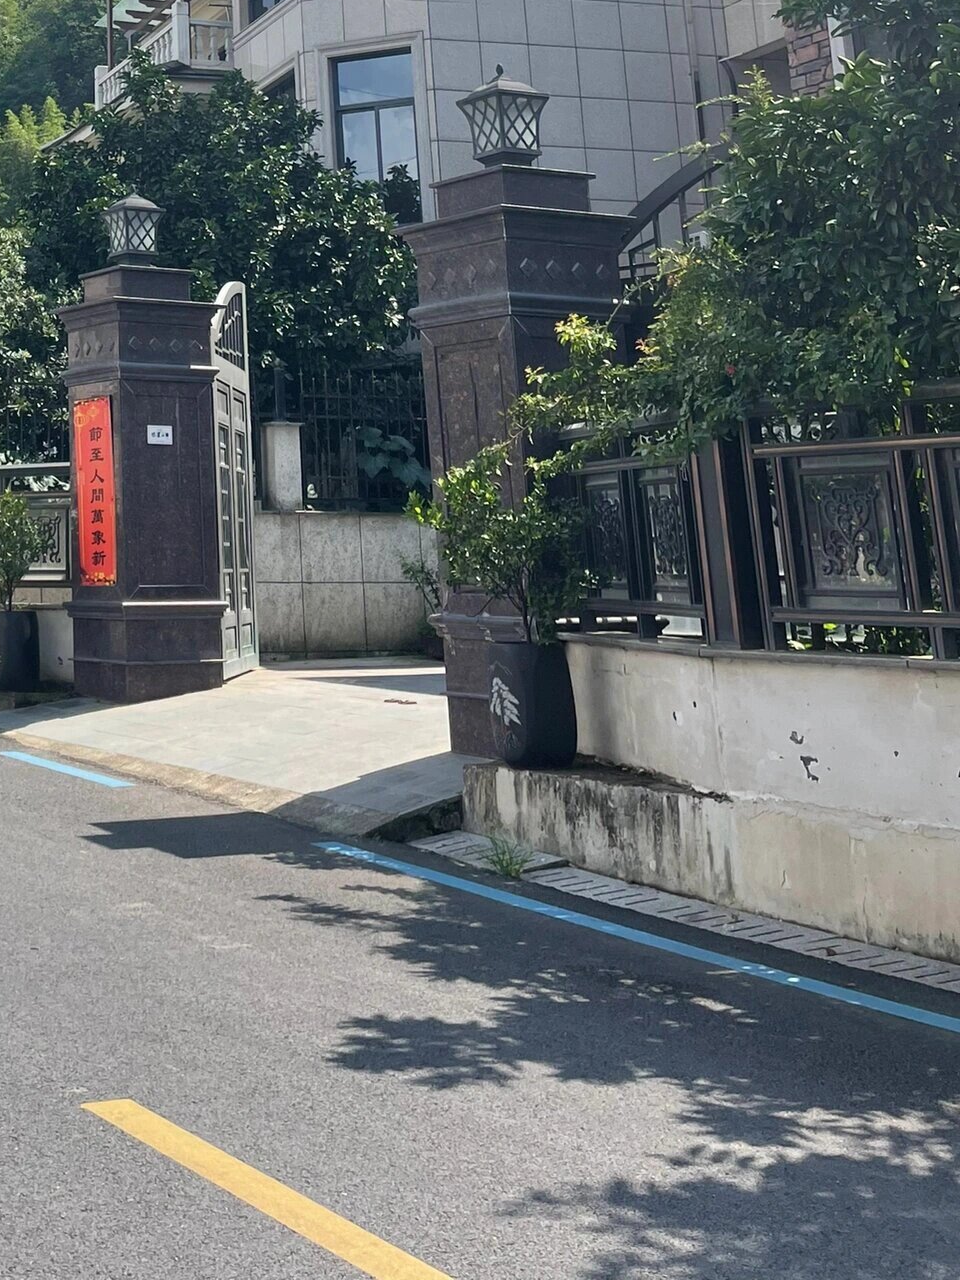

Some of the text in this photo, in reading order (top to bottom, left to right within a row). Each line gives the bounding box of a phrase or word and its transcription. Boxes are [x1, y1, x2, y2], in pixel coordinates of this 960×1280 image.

[88, 426, 107, 567] 節至人間萬象新
